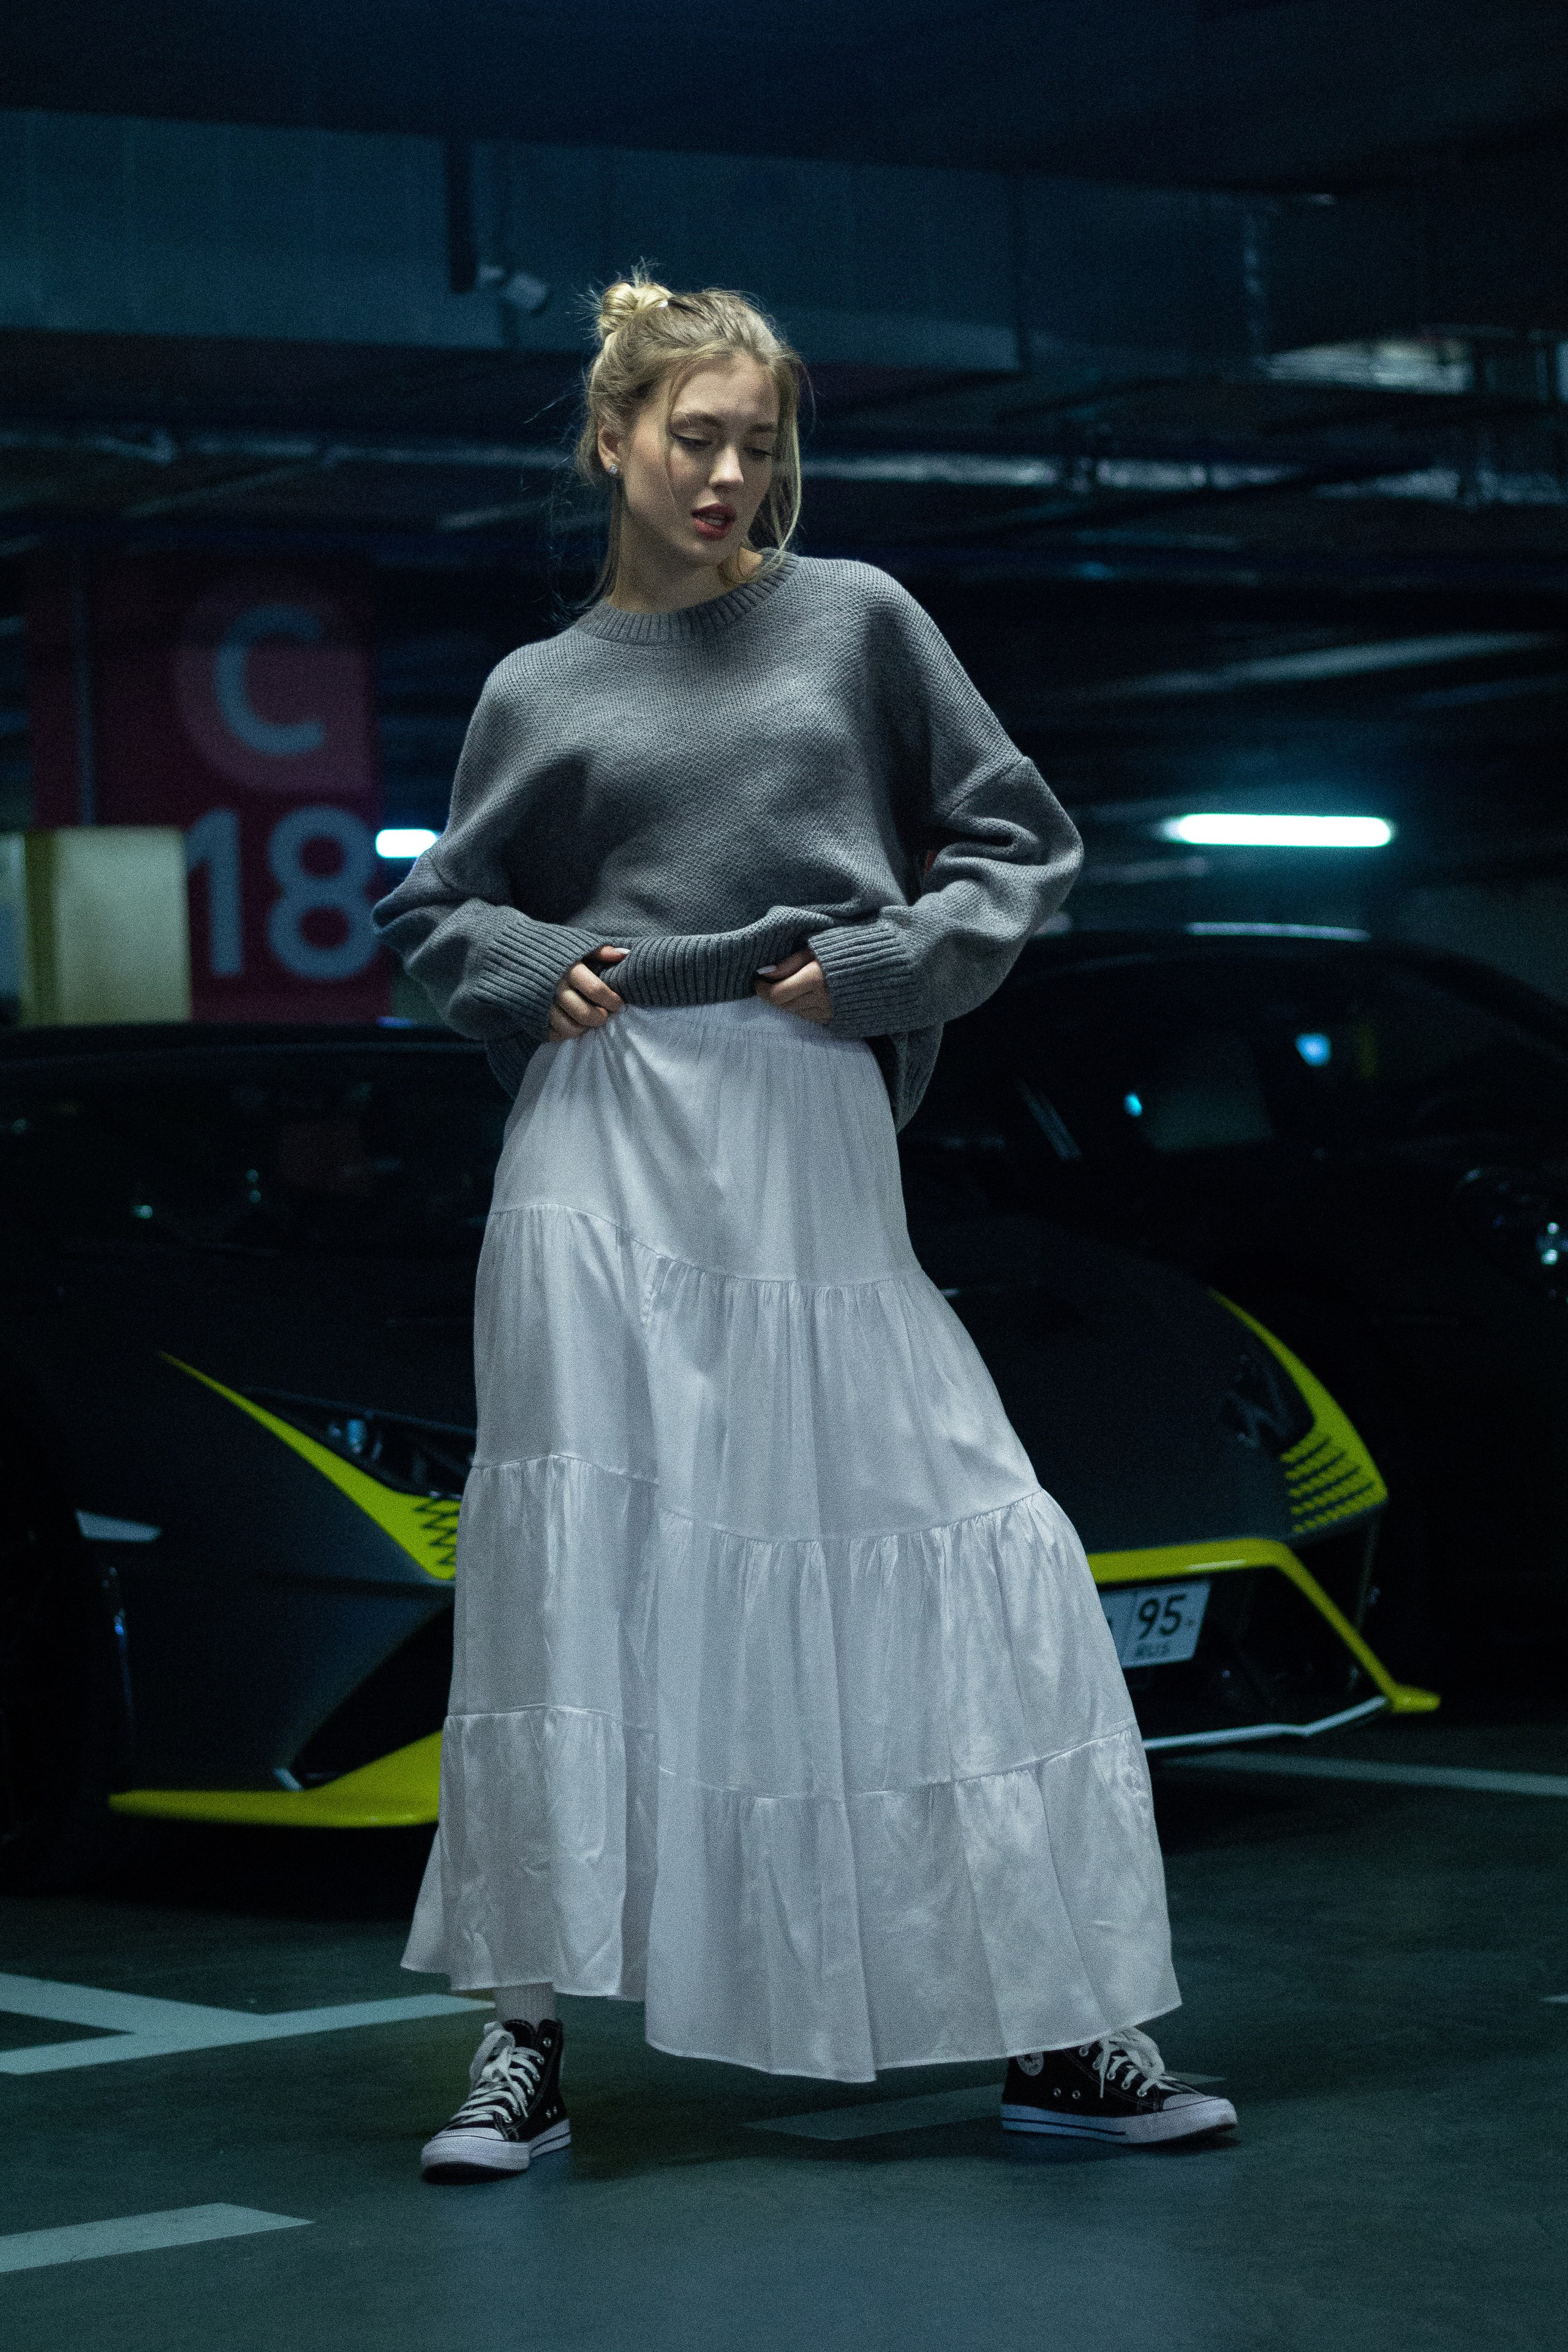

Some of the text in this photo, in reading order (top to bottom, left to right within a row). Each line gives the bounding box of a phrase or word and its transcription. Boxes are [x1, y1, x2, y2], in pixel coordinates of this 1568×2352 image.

[214, 605, 325, 756] C
[186, 805, 381, 981] 18
[1138, 1594, 1186, 1640] 95
